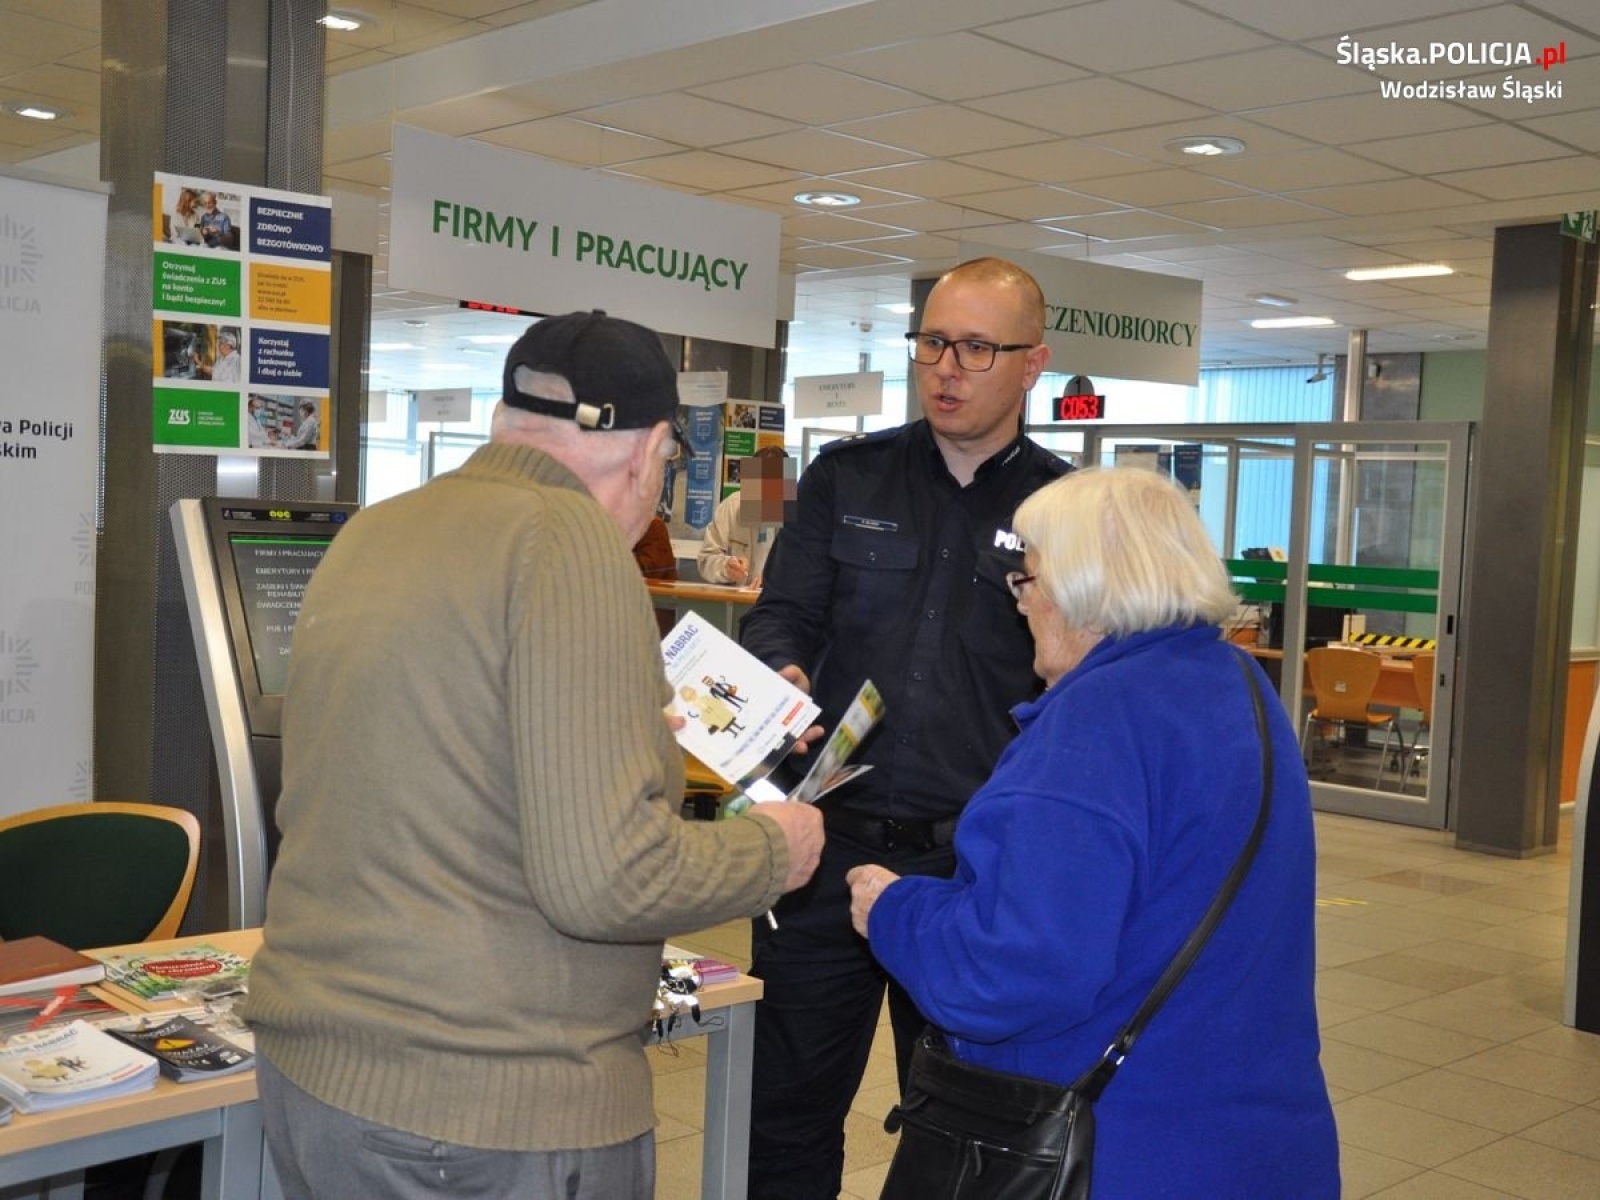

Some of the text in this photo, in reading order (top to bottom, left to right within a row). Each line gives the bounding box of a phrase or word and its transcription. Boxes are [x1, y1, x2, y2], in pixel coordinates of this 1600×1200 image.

[256, 207, 304, 220] BEZPIECZNIE
[256, 222, 292, 233] ZDROWO
[256, 238, 324, 252] BEZGOTÓWKOWO
[433, 199, 748, 291] FIRMY I PRACUJĄCY
[211, 277, 227, 286] ZUS
[1044, 305, 1197, 347] CZENIOBIORCY
[168, 409, 191, 425] ZUS
[0, 419, 73, 441] a Policji
[0, 442, 37, 459] kim
